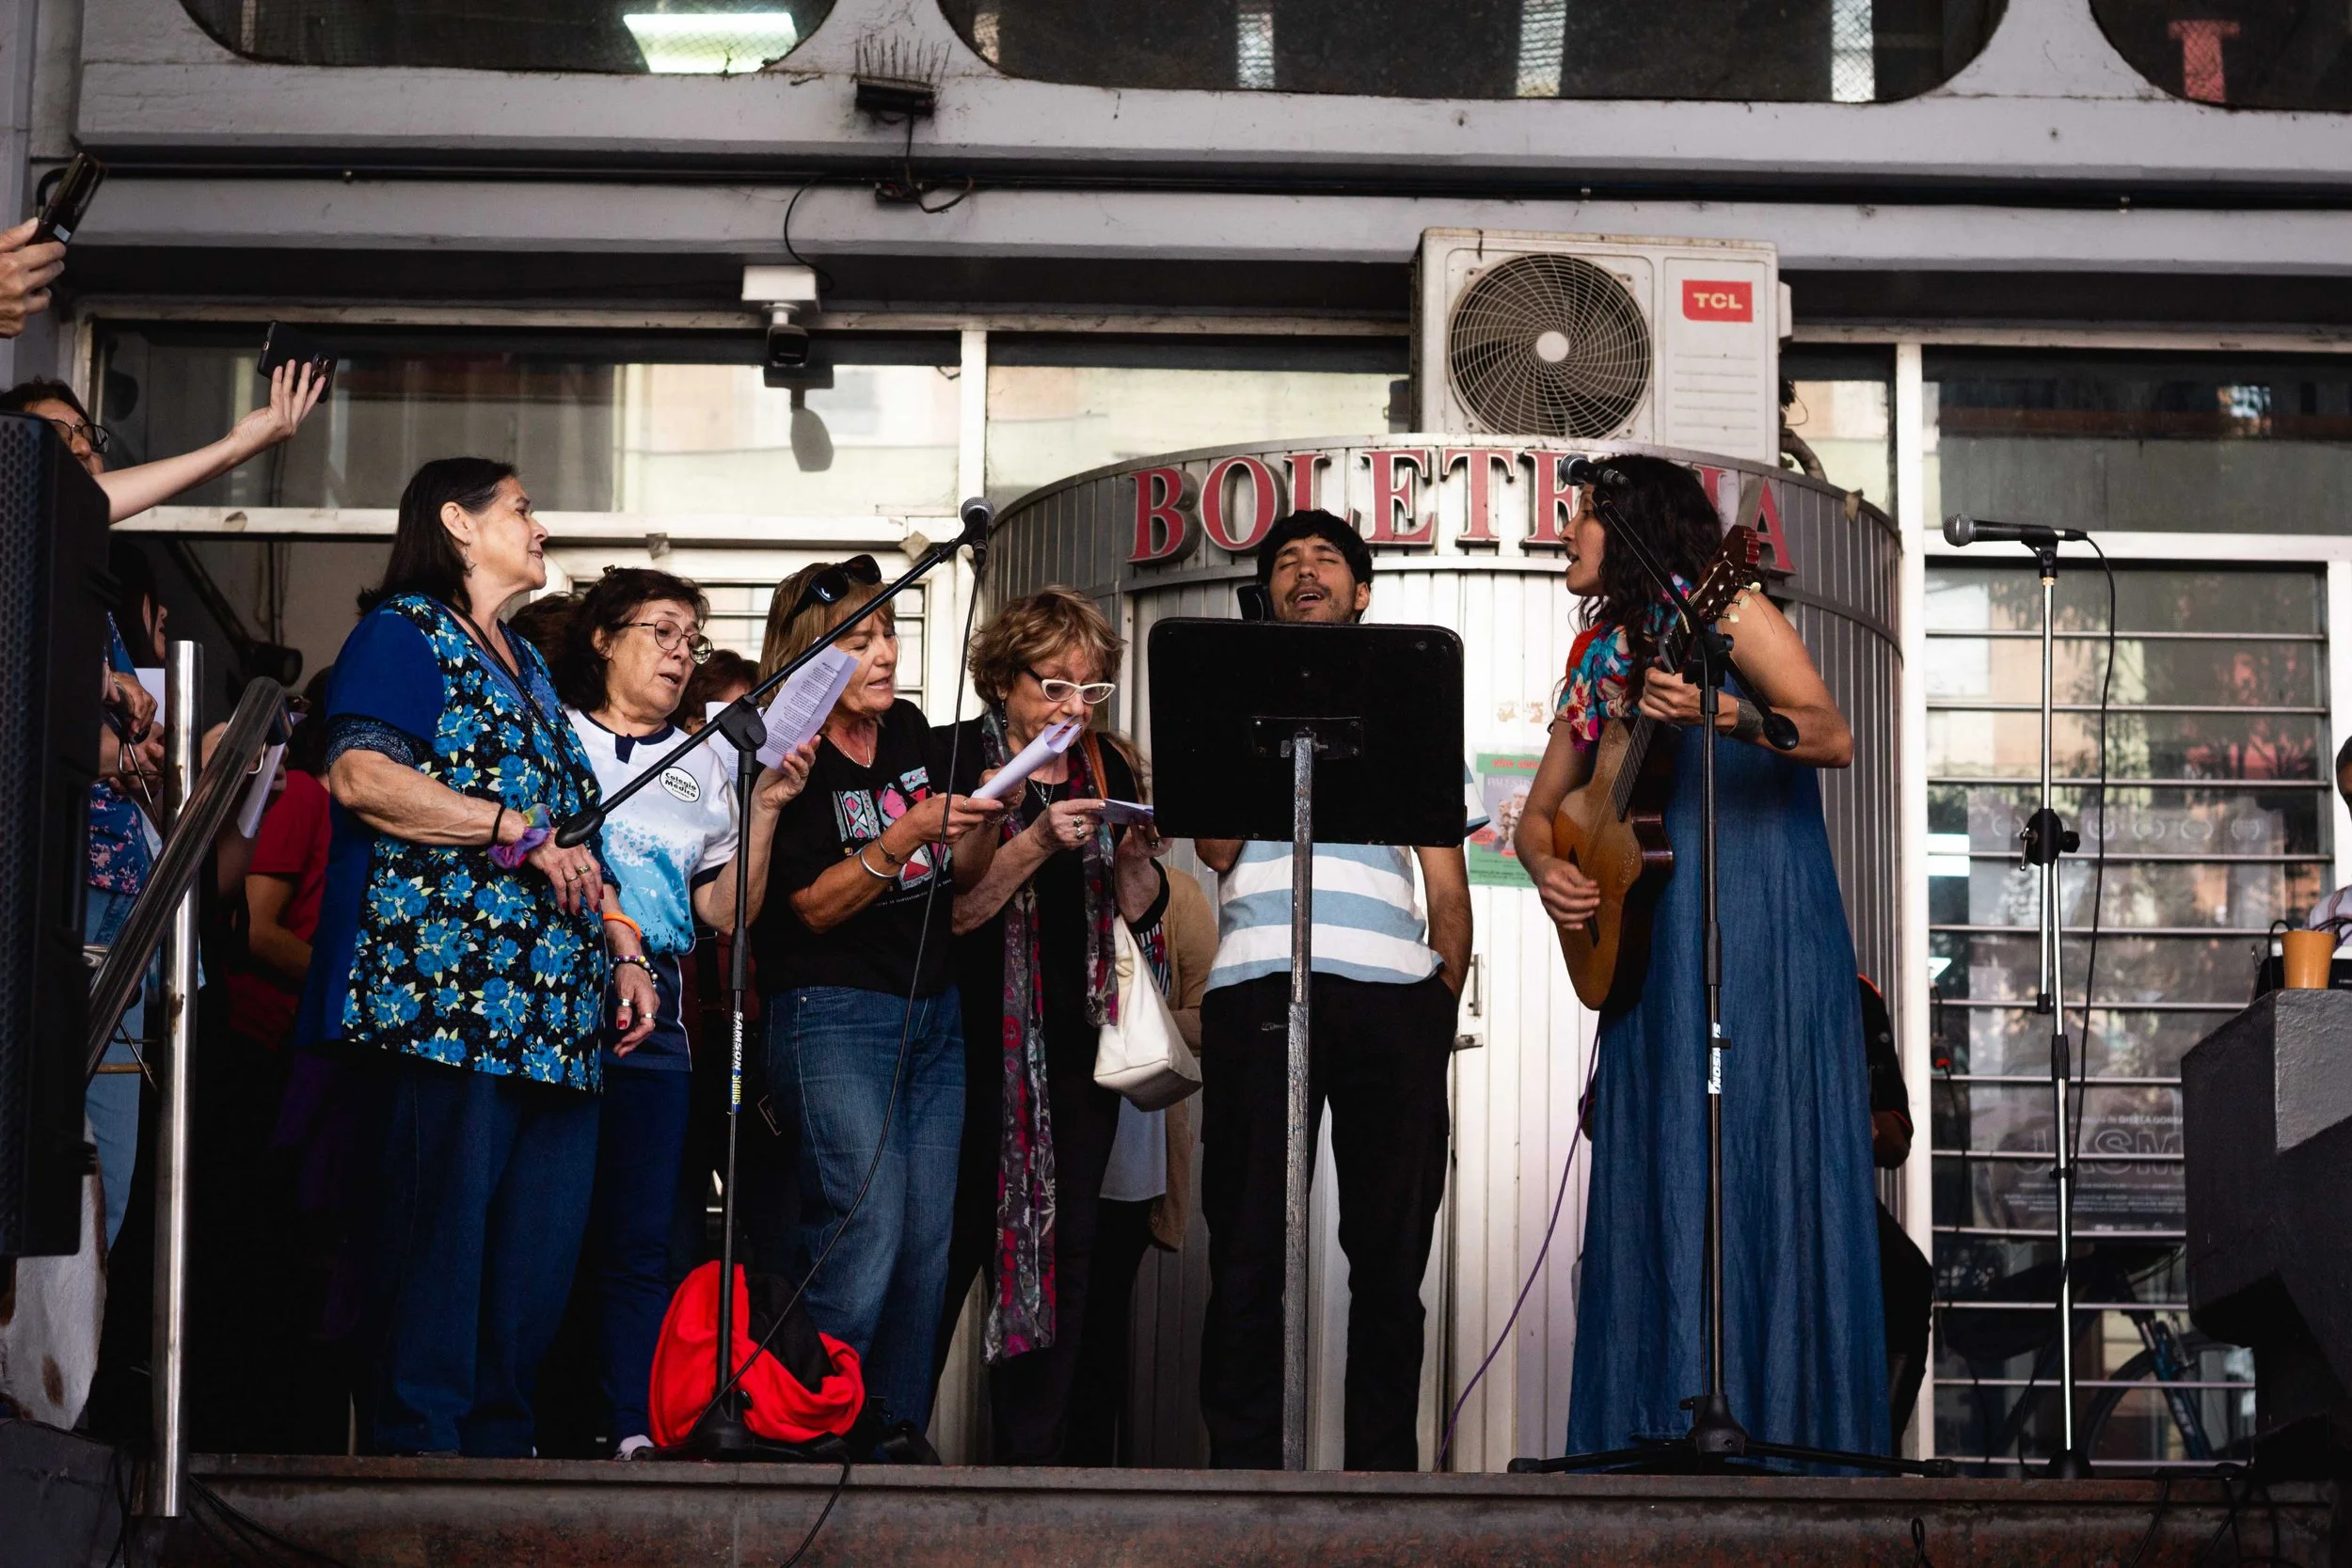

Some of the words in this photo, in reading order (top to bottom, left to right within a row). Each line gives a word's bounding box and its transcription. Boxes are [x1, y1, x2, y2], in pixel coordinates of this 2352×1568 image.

[1692, 293, 1743, 309] TCL
[1127, 447, 1798, 572] BOLETEA
[665, 772, 696, 790] Colegio
[734, 1011, 743, 1071] SAMSON
